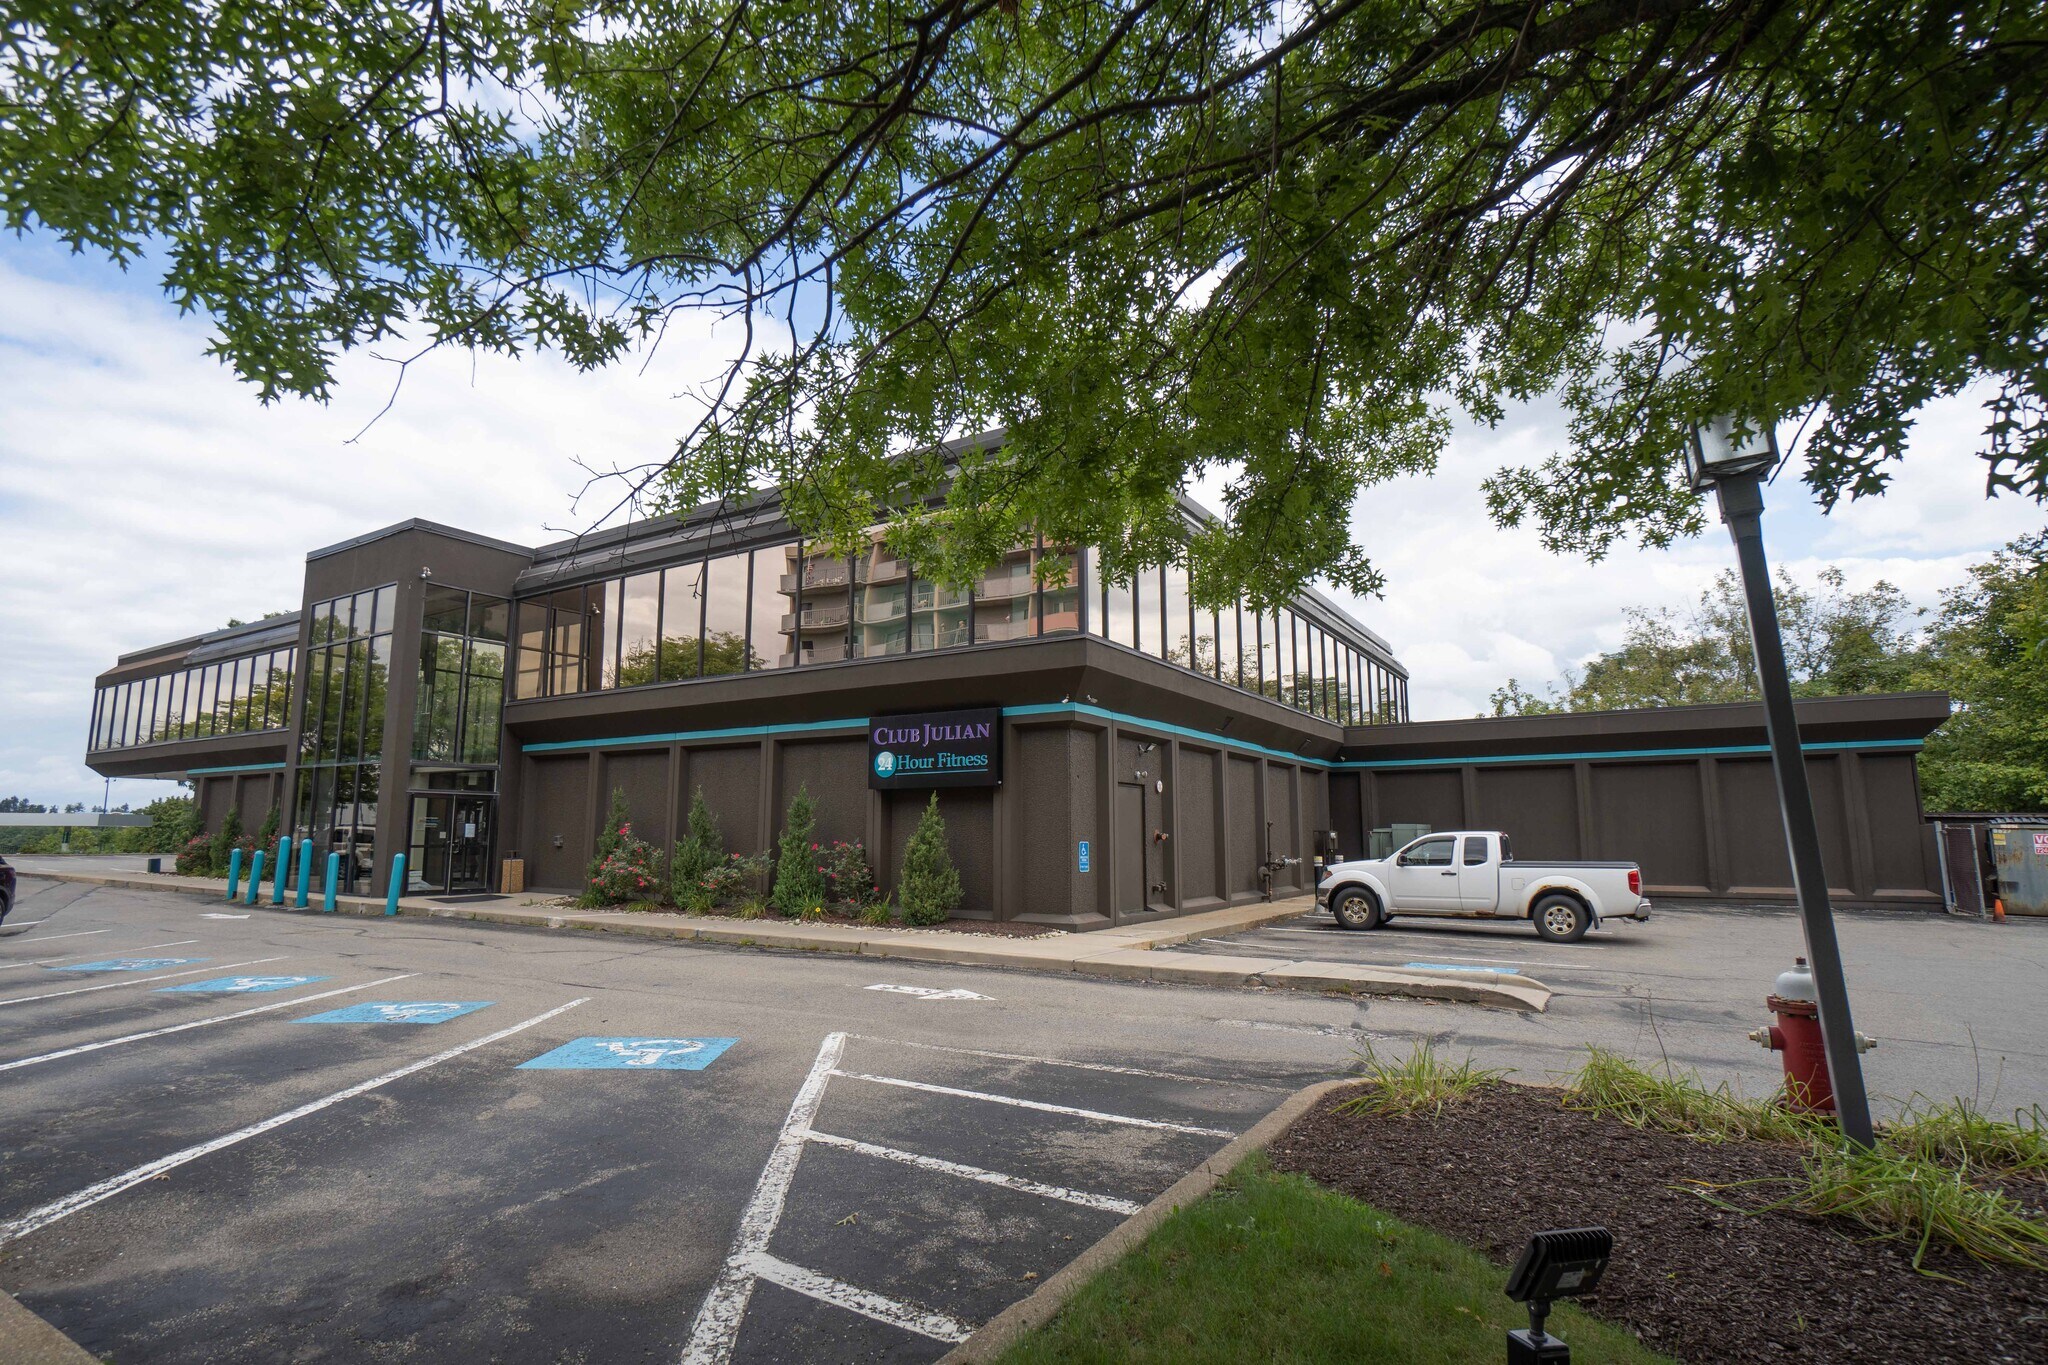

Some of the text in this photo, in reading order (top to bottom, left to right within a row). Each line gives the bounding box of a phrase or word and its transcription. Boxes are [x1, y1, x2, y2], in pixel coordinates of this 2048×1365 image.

[873, 723, 991, 747] CLUB JULIAN
[878, 752, 988, 771] 24 Hour Fitness
